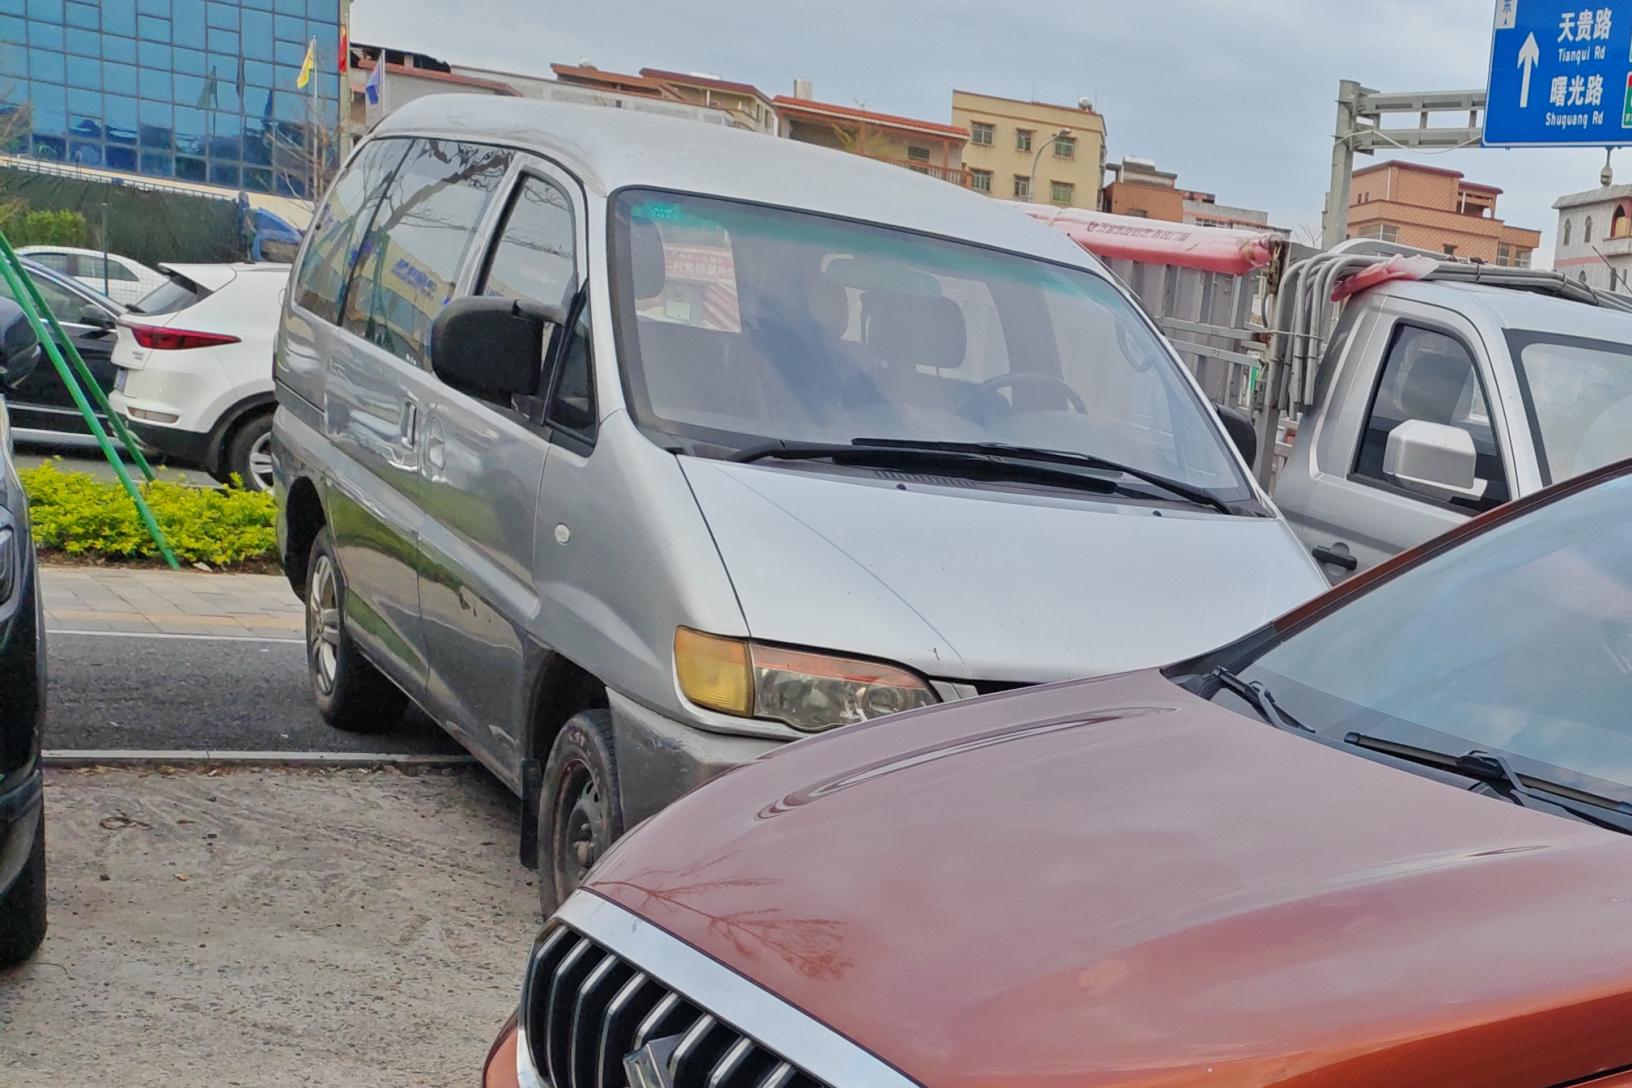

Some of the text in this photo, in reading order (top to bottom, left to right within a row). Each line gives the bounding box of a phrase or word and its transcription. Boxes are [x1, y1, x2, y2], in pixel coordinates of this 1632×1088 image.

[1557, 8, 1612, 43] 天贵路
[1594, 46, 1606, 60] Rd
[1549, 74, 1604, 107] 曙光路
[1545, 111, 1604, 130] Shuguang Rd
